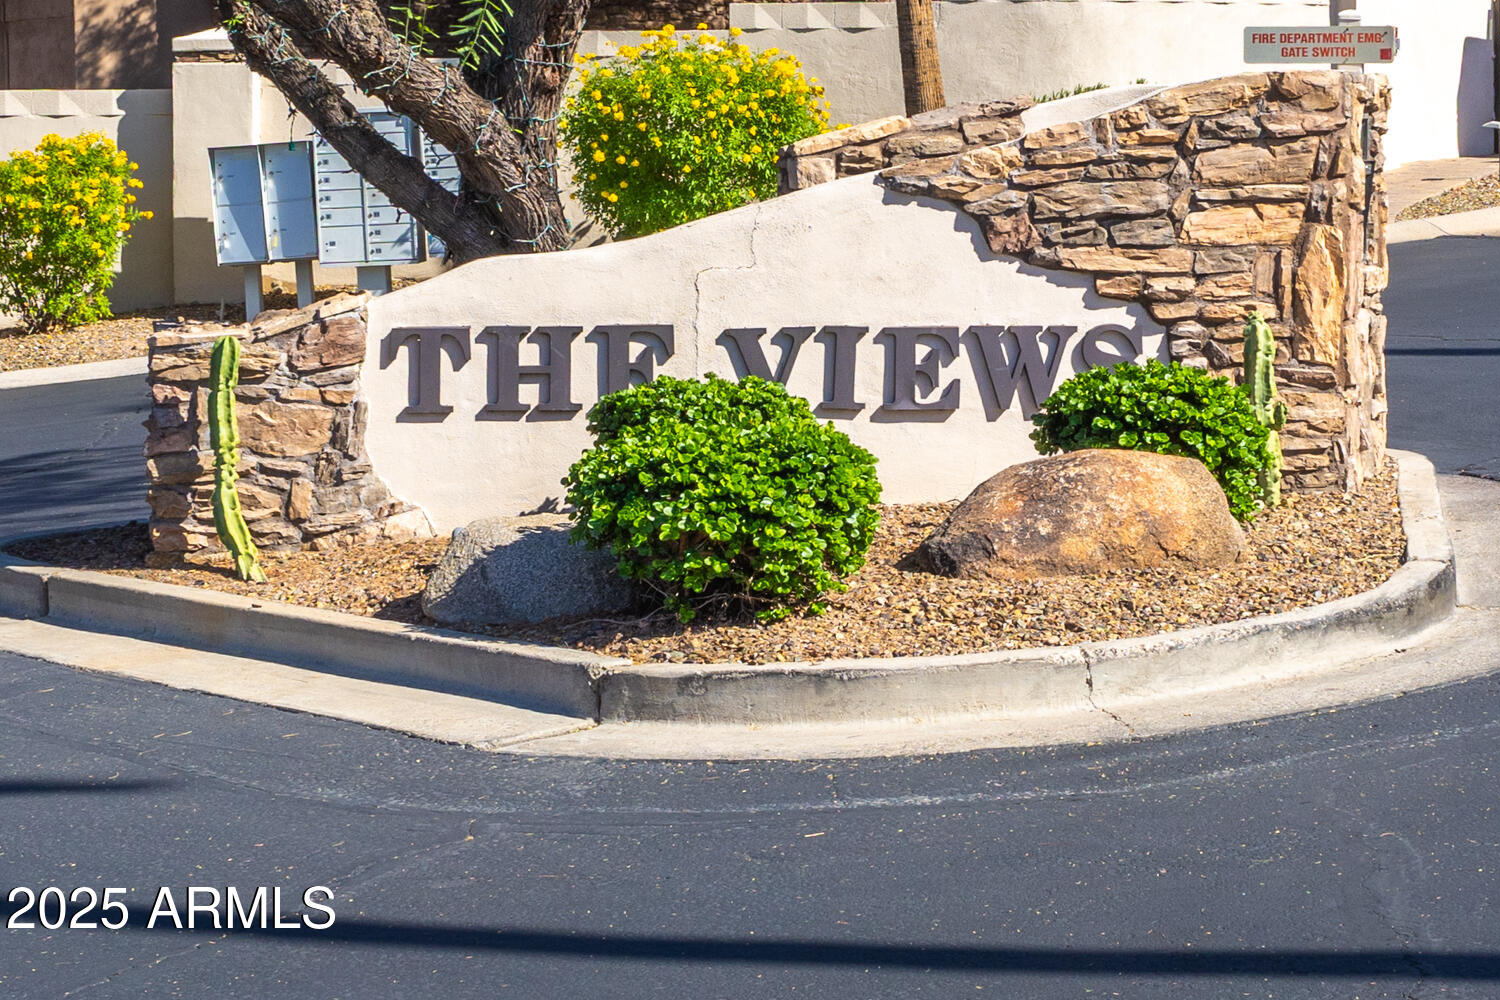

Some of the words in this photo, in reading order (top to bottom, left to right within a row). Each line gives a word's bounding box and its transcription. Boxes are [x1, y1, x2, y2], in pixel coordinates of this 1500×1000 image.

[1252, 33, 1276, 44] FIRE
[1280, 32, 1353, 44] DEPARTMENT
[1357, 32, 1385, 44] EMG.
[1281, 47, 1308, 58] GATE
[1312, 47, 1356, 58] SWITCH
[383, 325, 674, 416] THE
